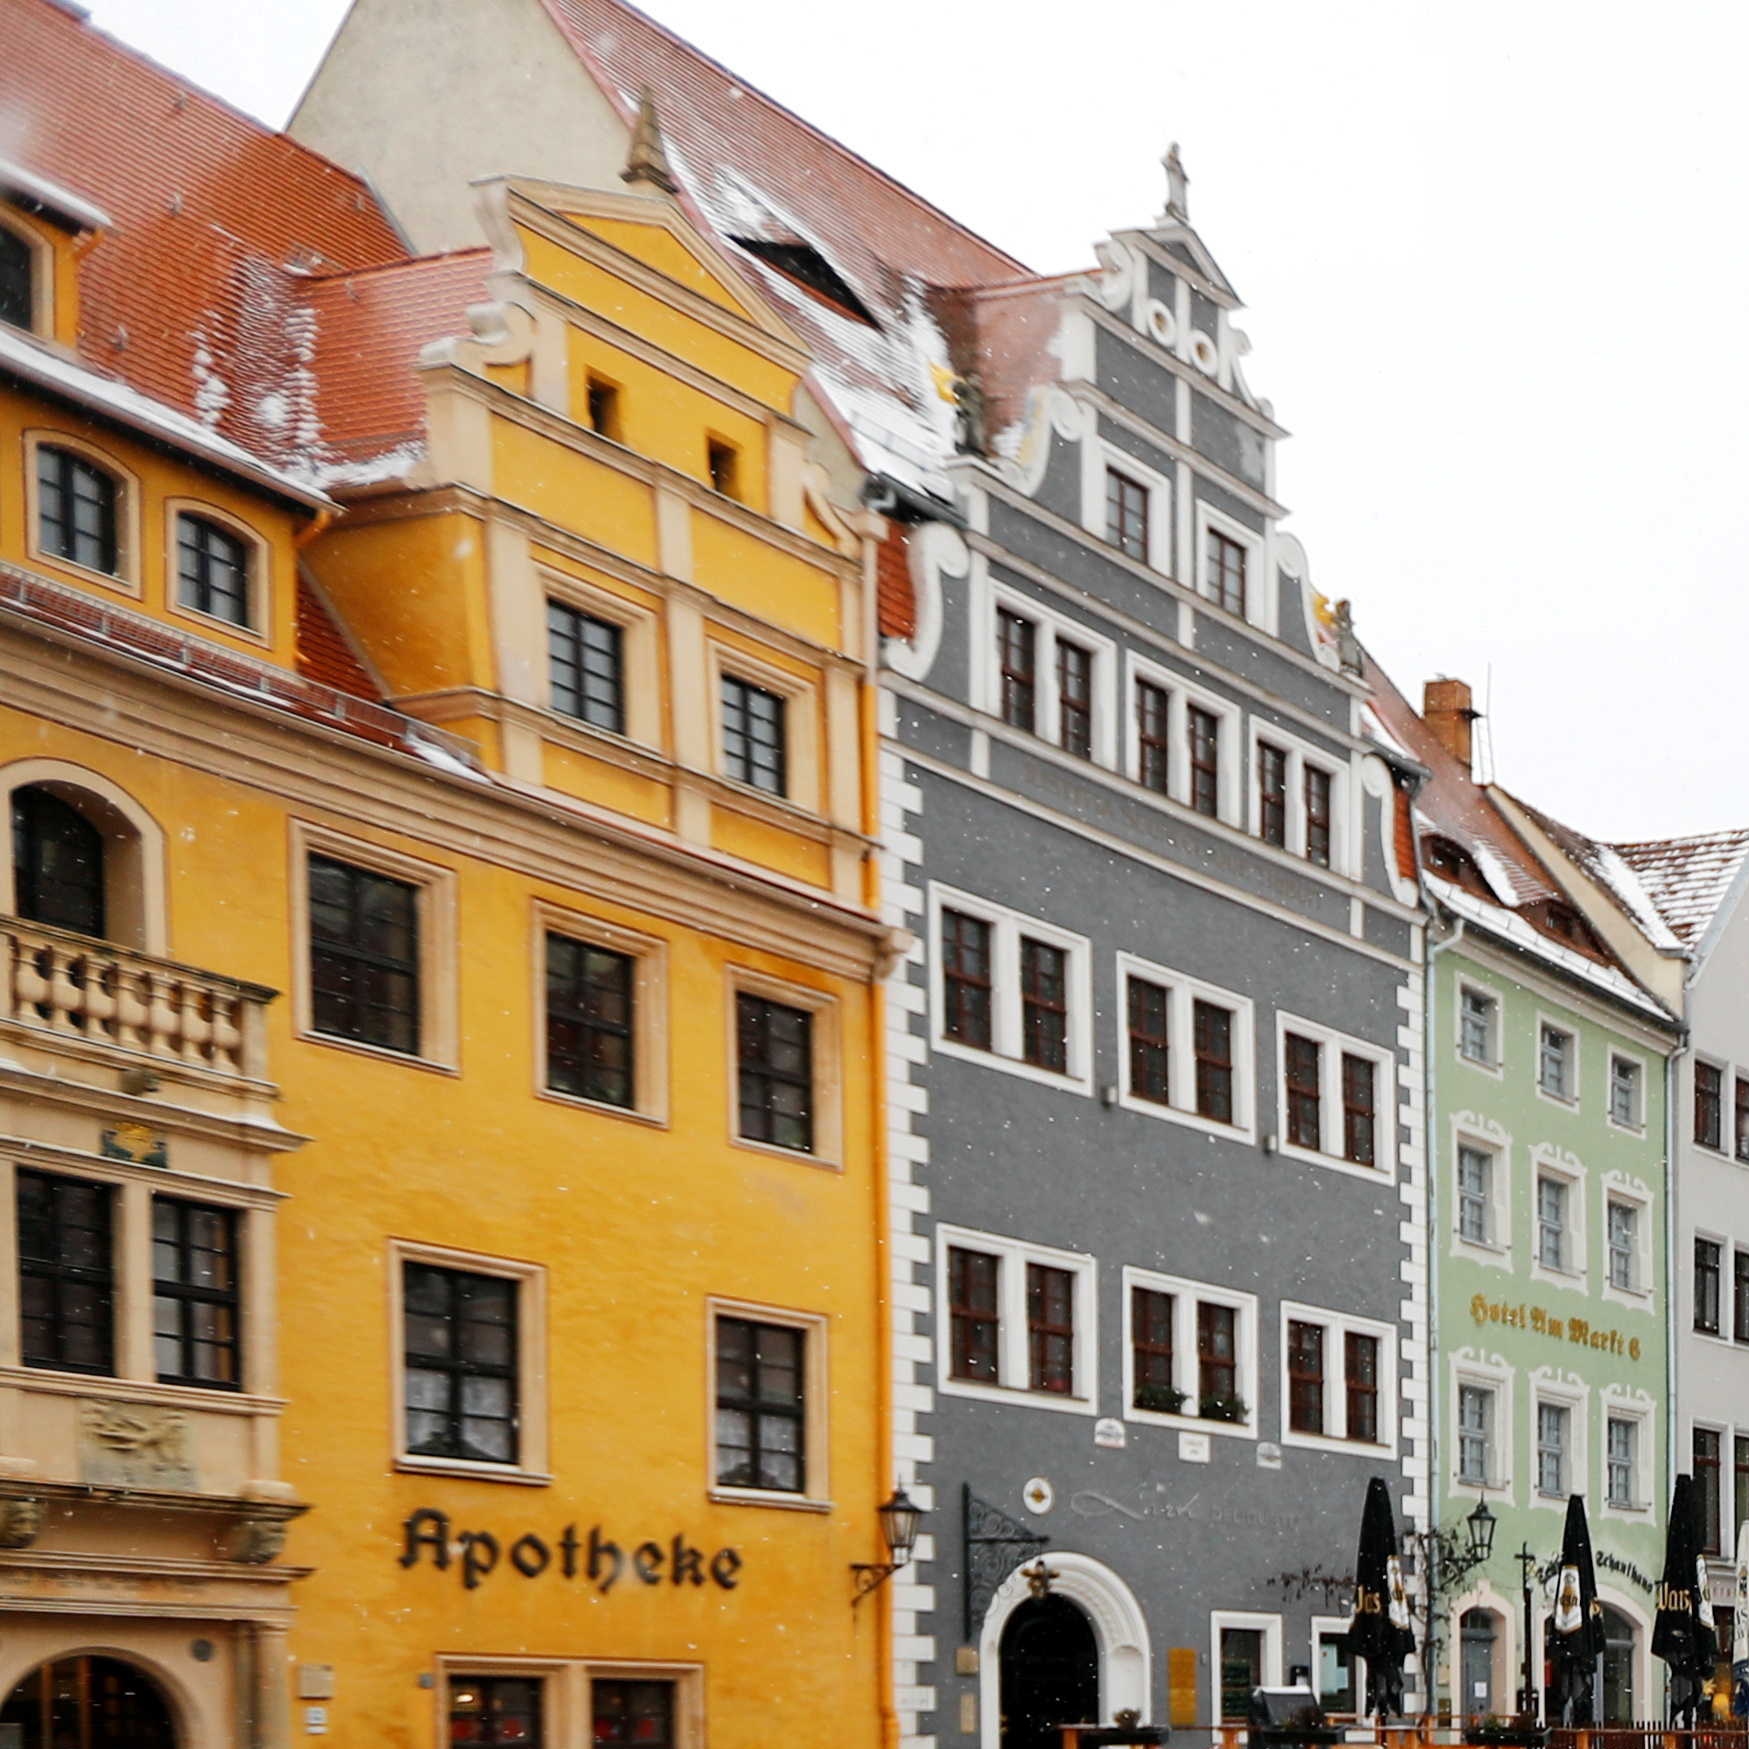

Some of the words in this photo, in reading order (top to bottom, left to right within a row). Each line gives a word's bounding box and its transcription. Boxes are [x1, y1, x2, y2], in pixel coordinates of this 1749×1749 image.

[1470, 1293, 1526, 1329] Hotel
[1530, 1306, 1564, 1339] Am
[1568, 1317, 1625, 1356] Markt
[397, 1507, 743, 1595] Apotheke
